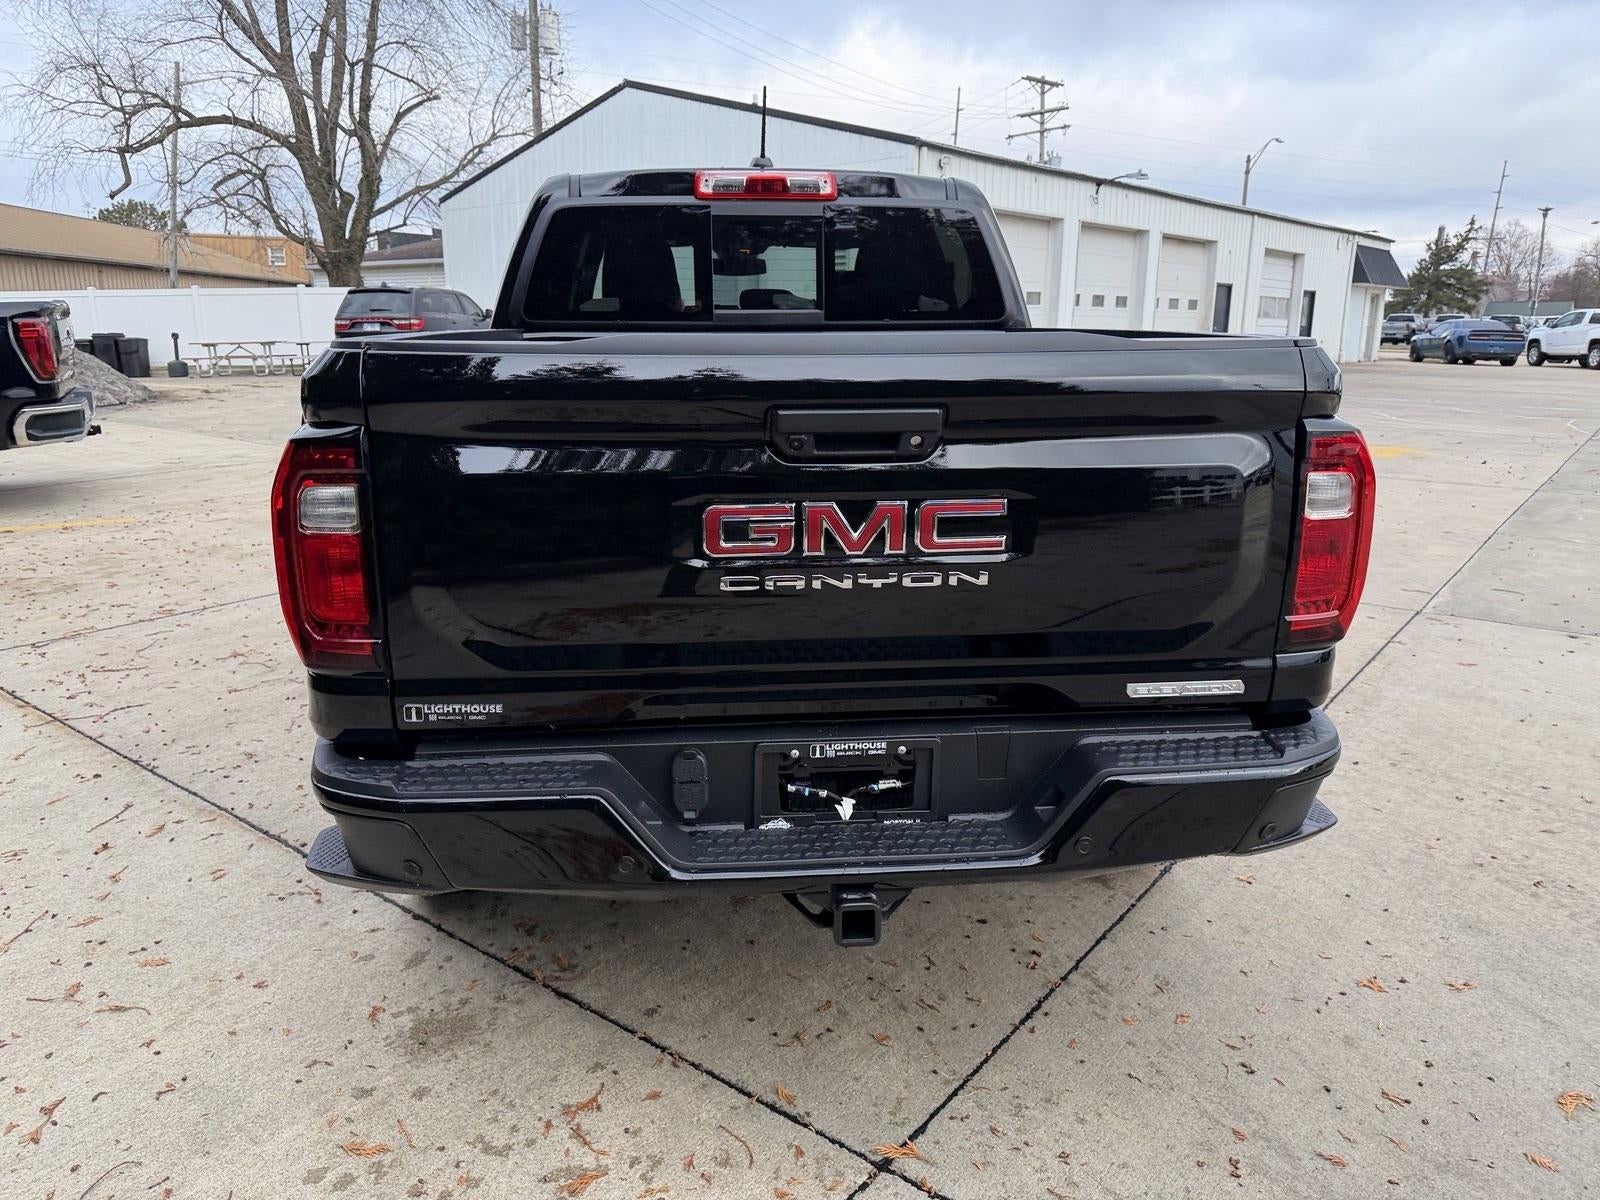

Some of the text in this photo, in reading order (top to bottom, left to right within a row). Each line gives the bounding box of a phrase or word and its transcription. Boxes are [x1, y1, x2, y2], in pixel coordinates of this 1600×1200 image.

[703, 498, 1007, 557] GMC
[719, 570, 989, 592] CANYON
[424, 704, 503, 713] LIGHTHOUSE
[826, 742, 887, 750] LIGHTHOUSE
